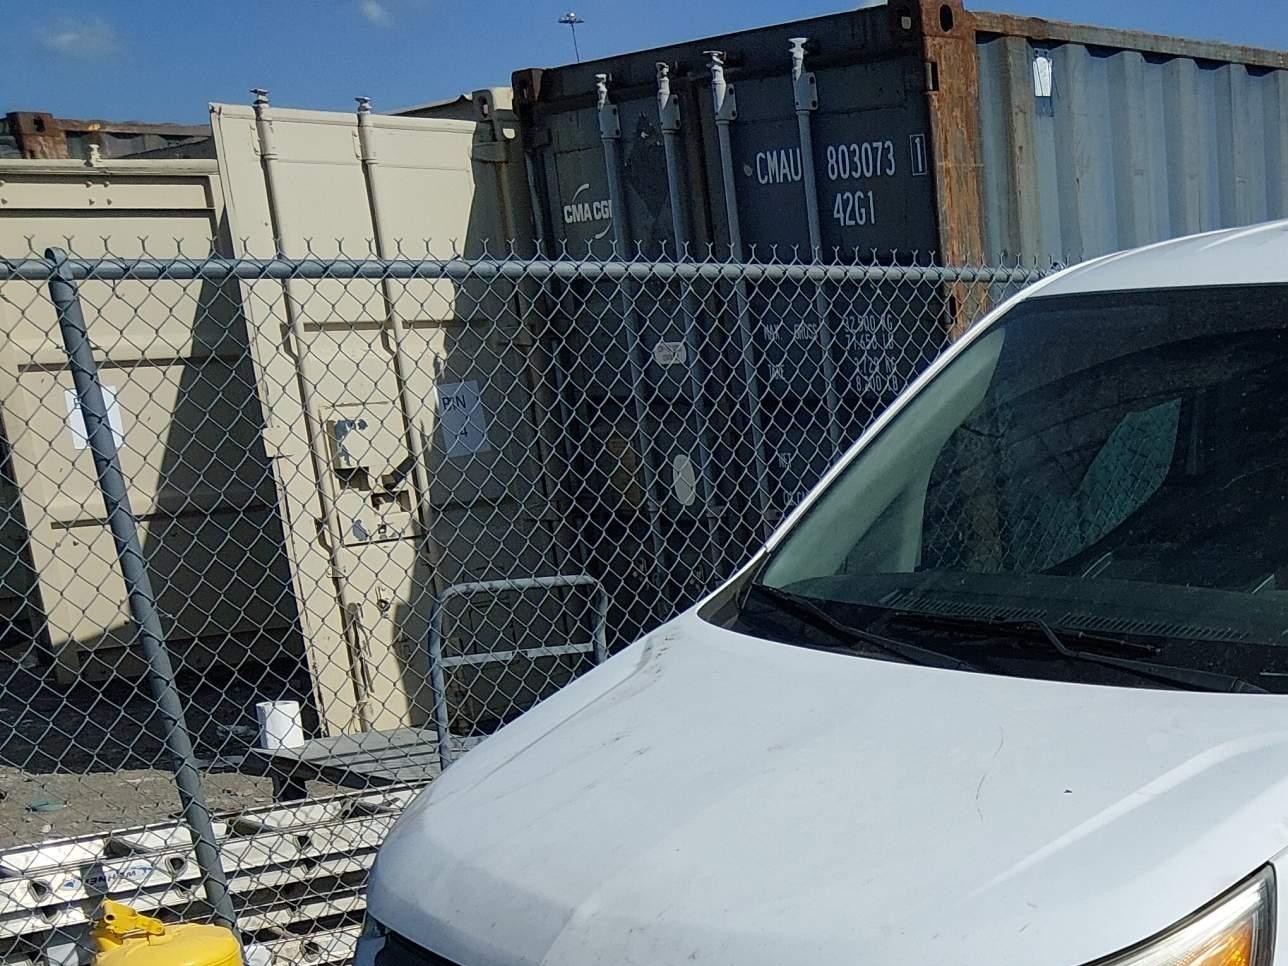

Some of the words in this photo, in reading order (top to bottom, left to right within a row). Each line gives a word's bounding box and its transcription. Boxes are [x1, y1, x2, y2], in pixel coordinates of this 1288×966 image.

[756, 148, 802, 184] CMAU
[827, 140, 896, 180] 803073
[912, 135, 926, 175] 1
[563, 203, 593, 223] CMA
[833, 190, 875, 226] 42G1
[843, 315, 876, 332] 32500
